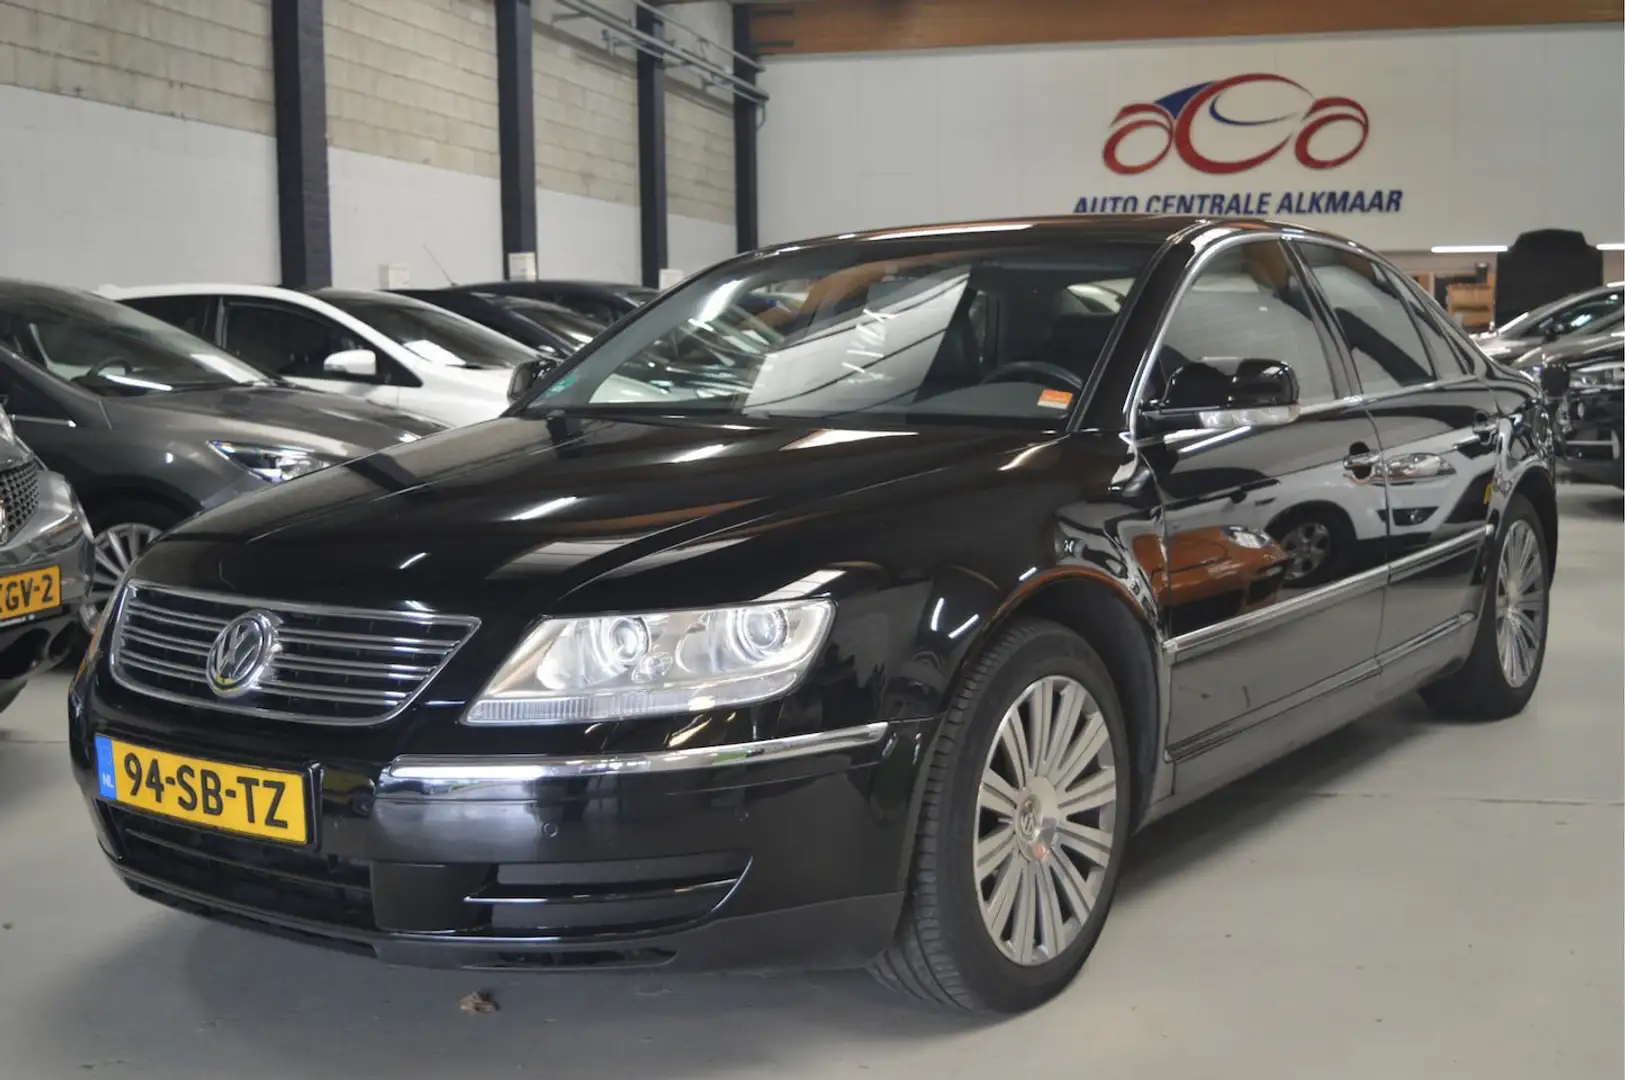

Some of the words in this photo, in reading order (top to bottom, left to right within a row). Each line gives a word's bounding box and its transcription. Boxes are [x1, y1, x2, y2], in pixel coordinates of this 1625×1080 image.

[1073, 196, 1138, 213] AUTO
[1145, 192, 1271, 215] CENTRALE
[1275, 190, 1403, 214] ALKMAAR
[0, 574, 53, 612] GV-2
[102, 772, 114, 788] NL
[123, 752, 288, 829] 94-SB-TZ
